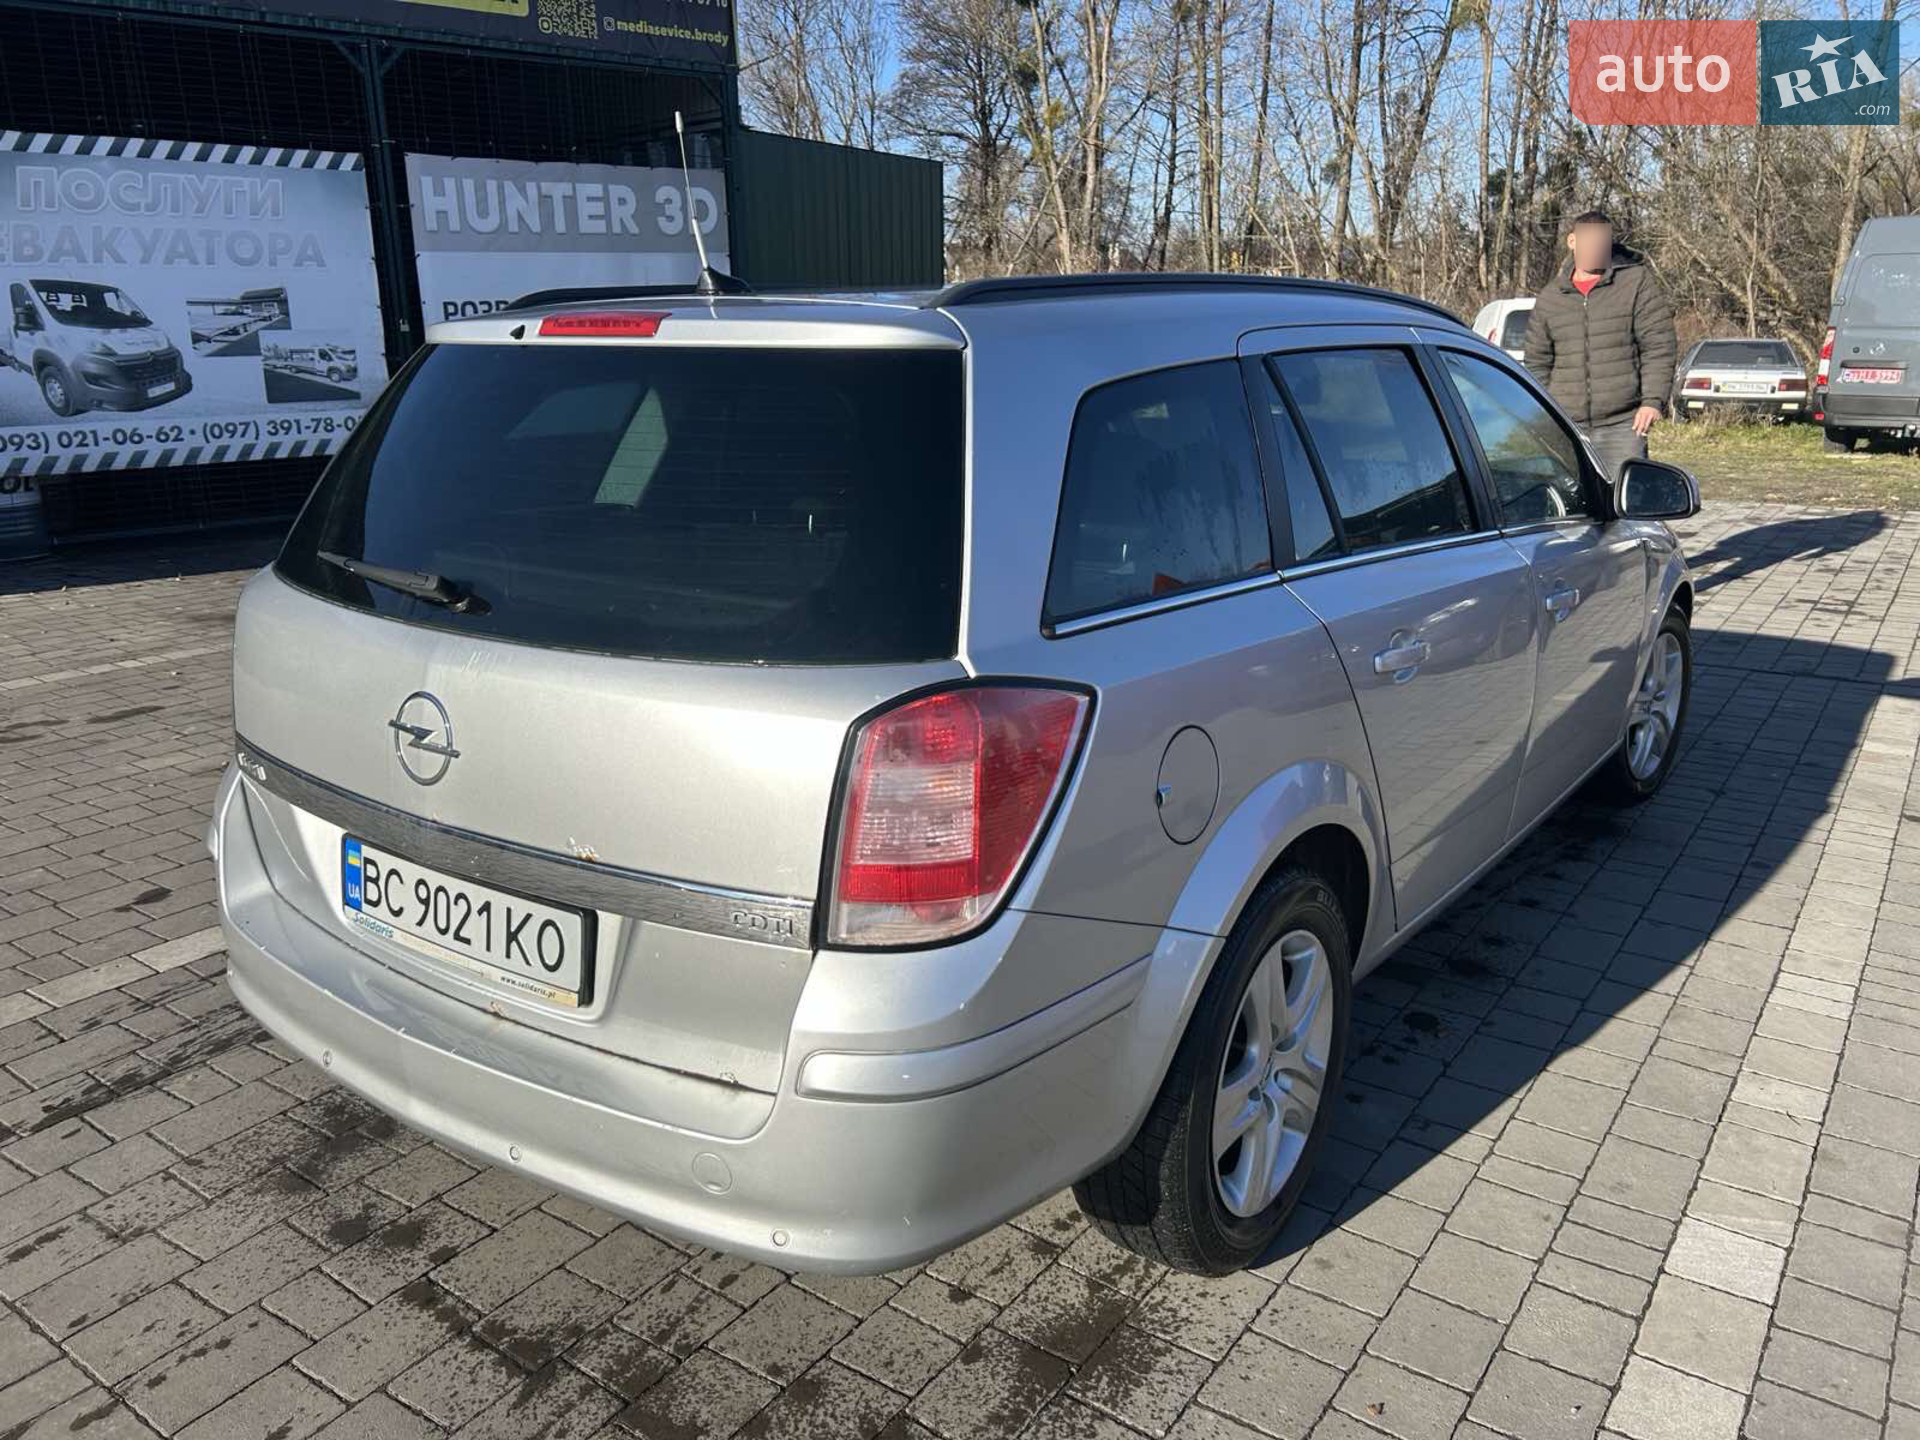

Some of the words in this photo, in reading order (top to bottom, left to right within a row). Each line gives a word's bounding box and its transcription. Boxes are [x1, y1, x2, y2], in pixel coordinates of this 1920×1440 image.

[616, 20, 729, 46] mediasevice.brody
[17, 167, 283, 219] ПОСЛУГИ
[420, 176, 640, 235] HUNTER
[655, 185, 719, 235] 3D
[57, 425, 184, 448] 021-06-62
[203, 420, 260, 444] (097)
[267, 414, 361, 436] 391-78-0
[348, 883, 361, 901] UA
[352, 912, 395, 938] Solidaris
[364, 856, 404, 917] BC
[414, 878, 492, 952] 9021
[505, 906, 565, 973] KO
